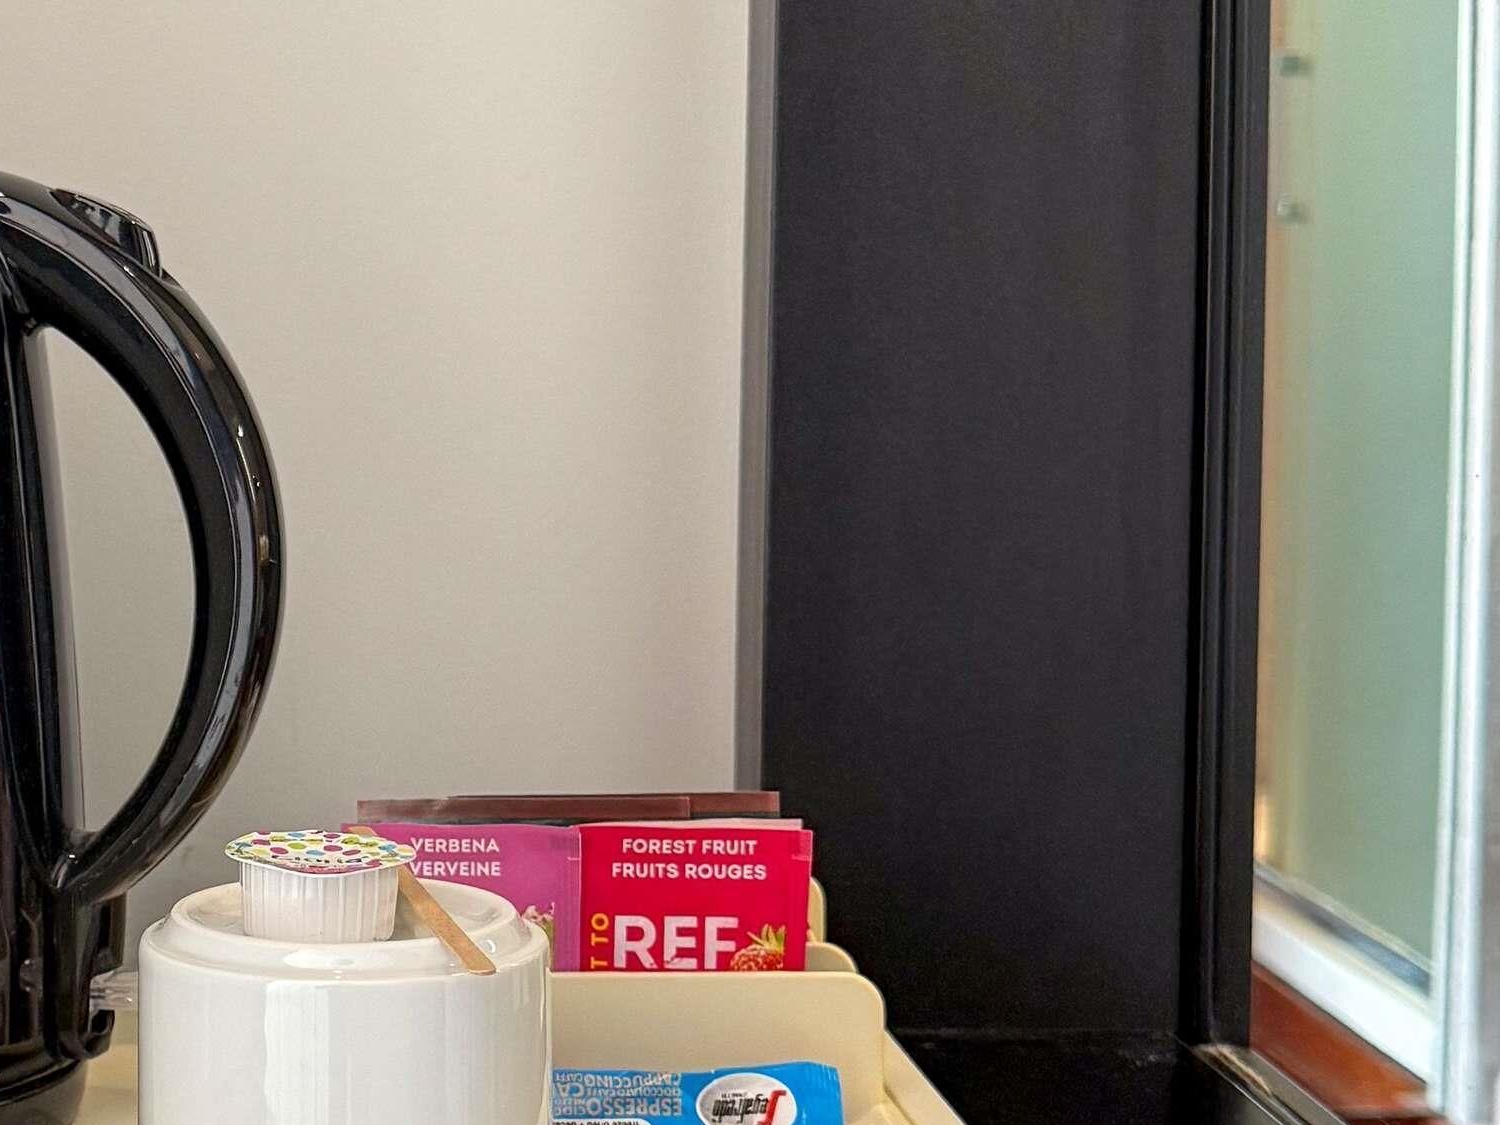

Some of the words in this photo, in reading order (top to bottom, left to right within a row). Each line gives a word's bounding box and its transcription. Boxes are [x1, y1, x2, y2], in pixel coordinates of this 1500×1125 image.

[409, 837, 500, 854] VERBENA
[621, 837, 698, 856] FOREST
[701, 838, 759, 857] FRUIT
[408, 860, 501, 877] VERVEINE
[611, 861, 681, 880] FRUITS
[684, 862, 768, 882] ROUGES
[590, 912, 610, 947] TO
[612, 914, 740, 971] REF
[585, 1072, 682, 1088] CAPPUCCINO
[586, 1097, 683, 1117] ESPRESSO
